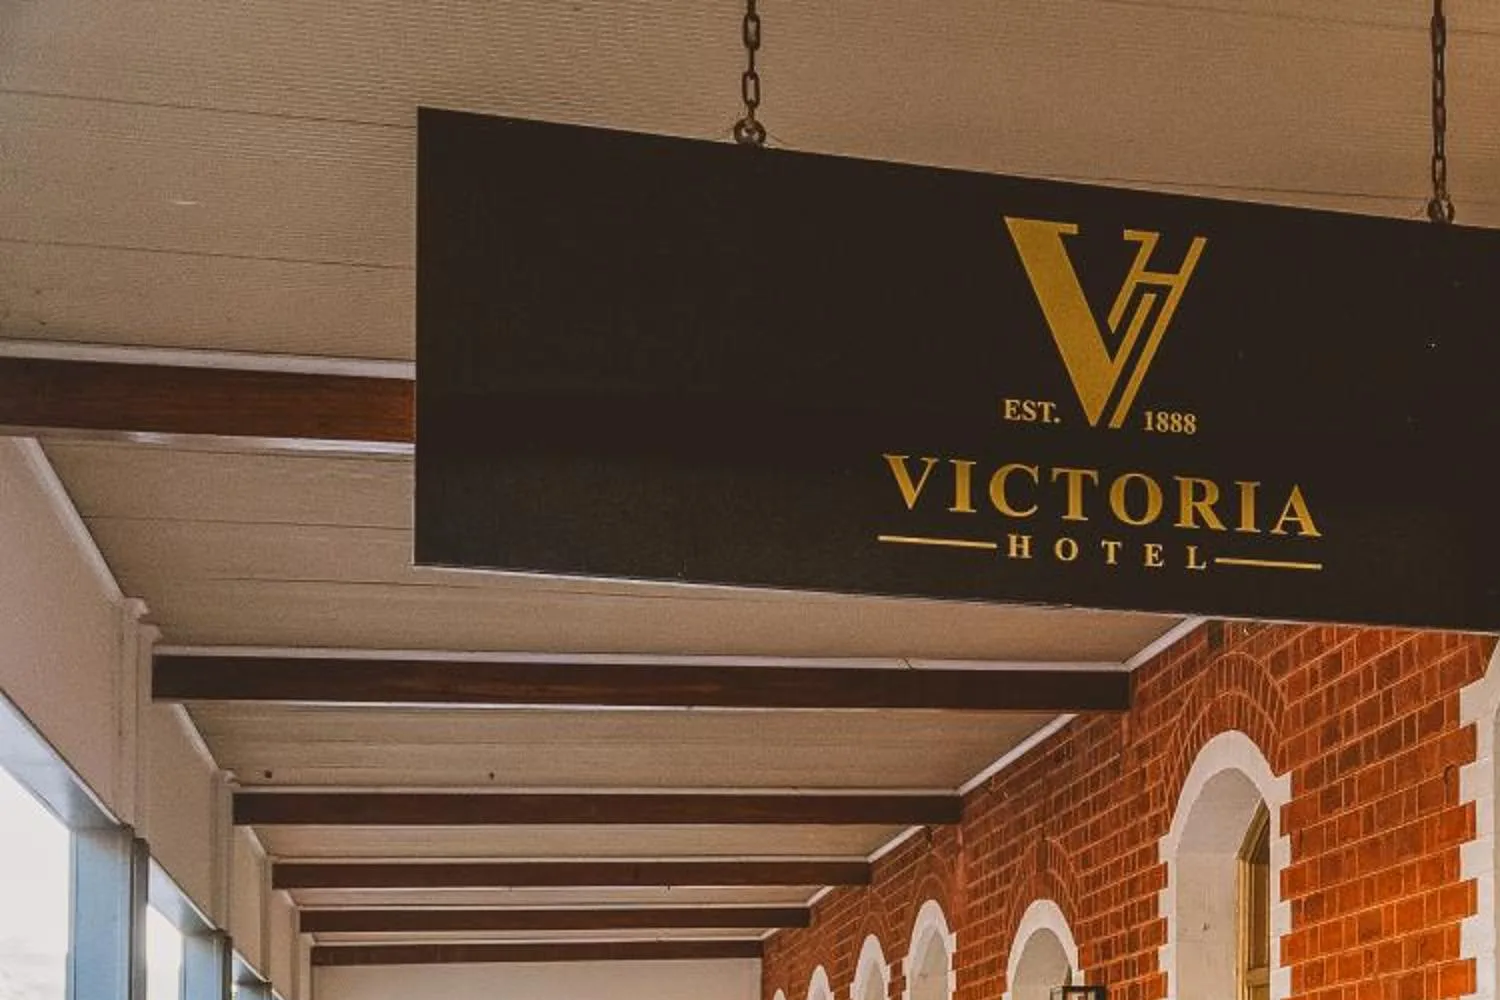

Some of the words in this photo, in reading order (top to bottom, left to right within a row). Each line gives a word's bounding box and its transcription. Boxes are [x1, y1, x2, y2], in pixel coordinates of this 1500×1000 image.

[1003, 398, 1061, 424] EST.
[1143, 410, 1197, 434] 1888
[882, 453, 1323, 538] VICTORIA
[1006, 532, 1208, 571] HOTEL
